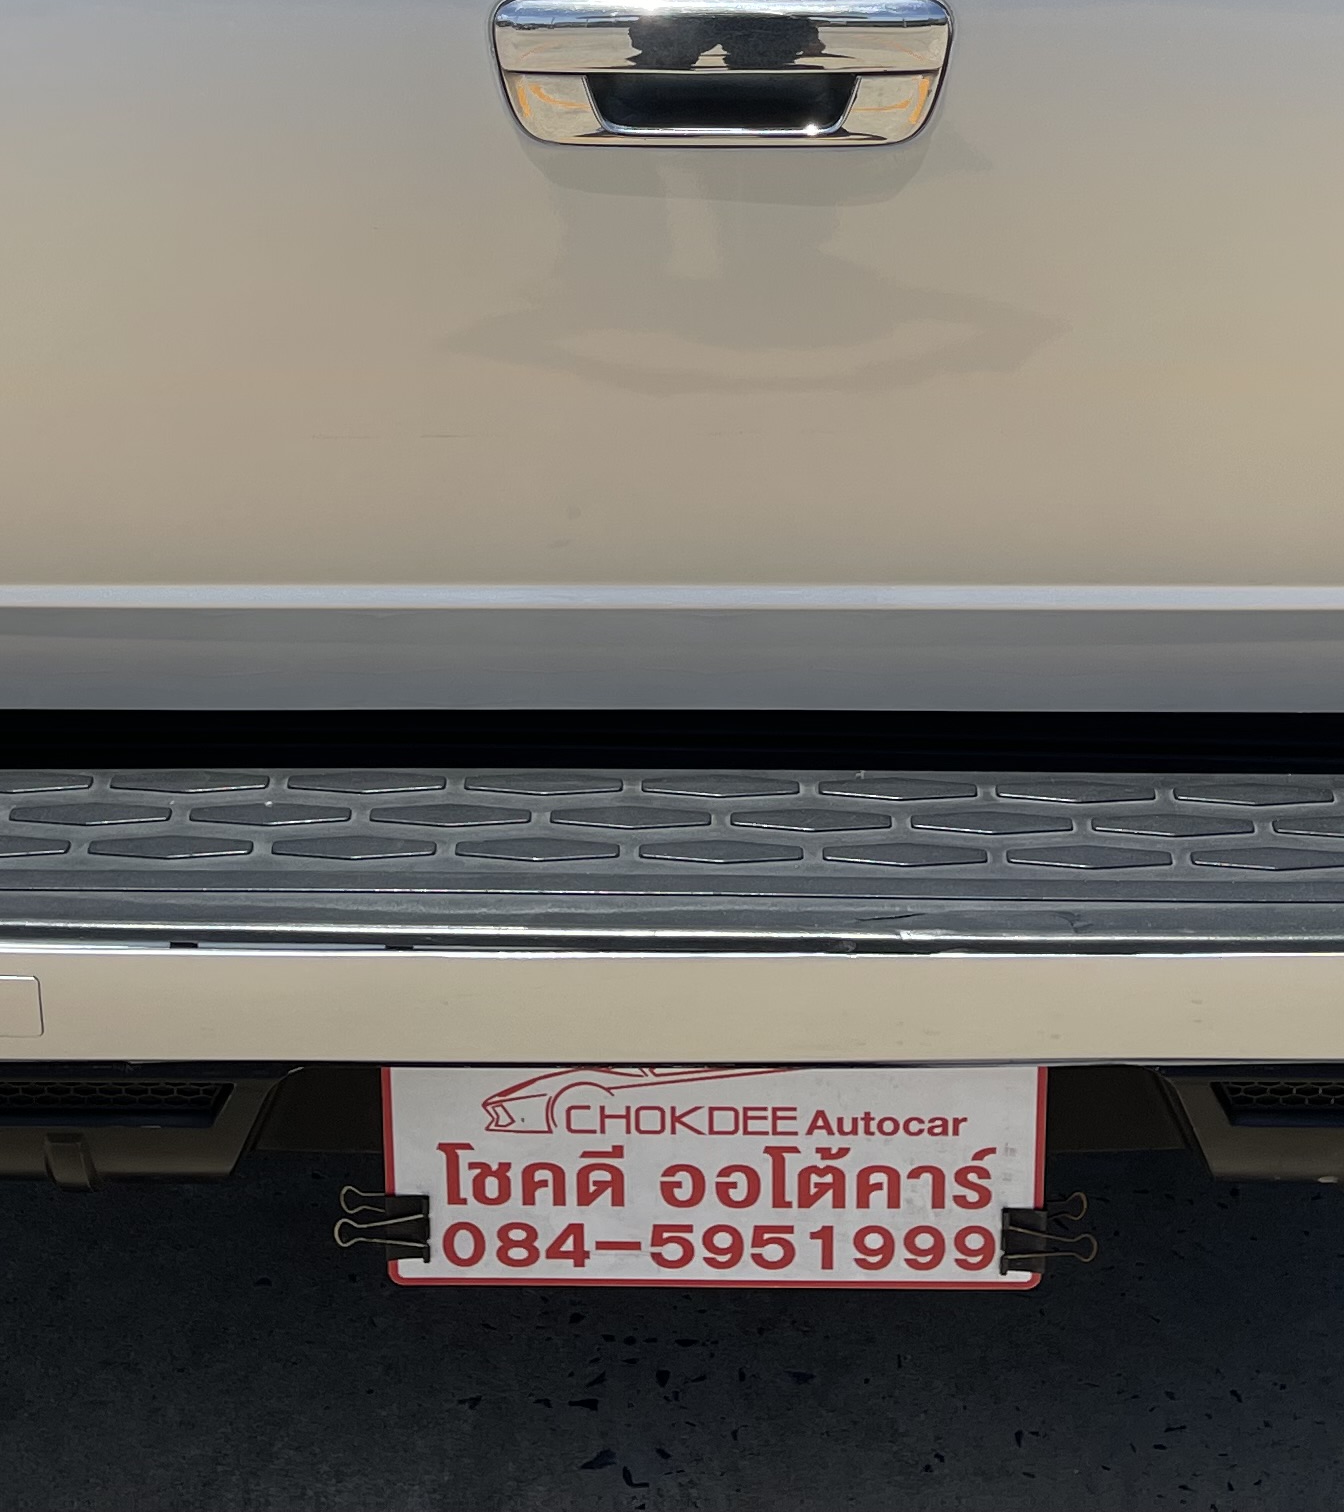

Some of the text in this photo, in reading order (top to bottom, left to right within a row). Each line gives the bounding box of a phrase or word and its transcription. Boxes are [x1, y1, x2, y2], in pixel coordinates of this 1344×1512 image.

[565, 1105, 968, 1137] CHOKDEE Autocar
[437, 1143, 997, 1209] โชคดี ออโต้คาร์
[442, 1224, 998, 1271] 084-5951999
